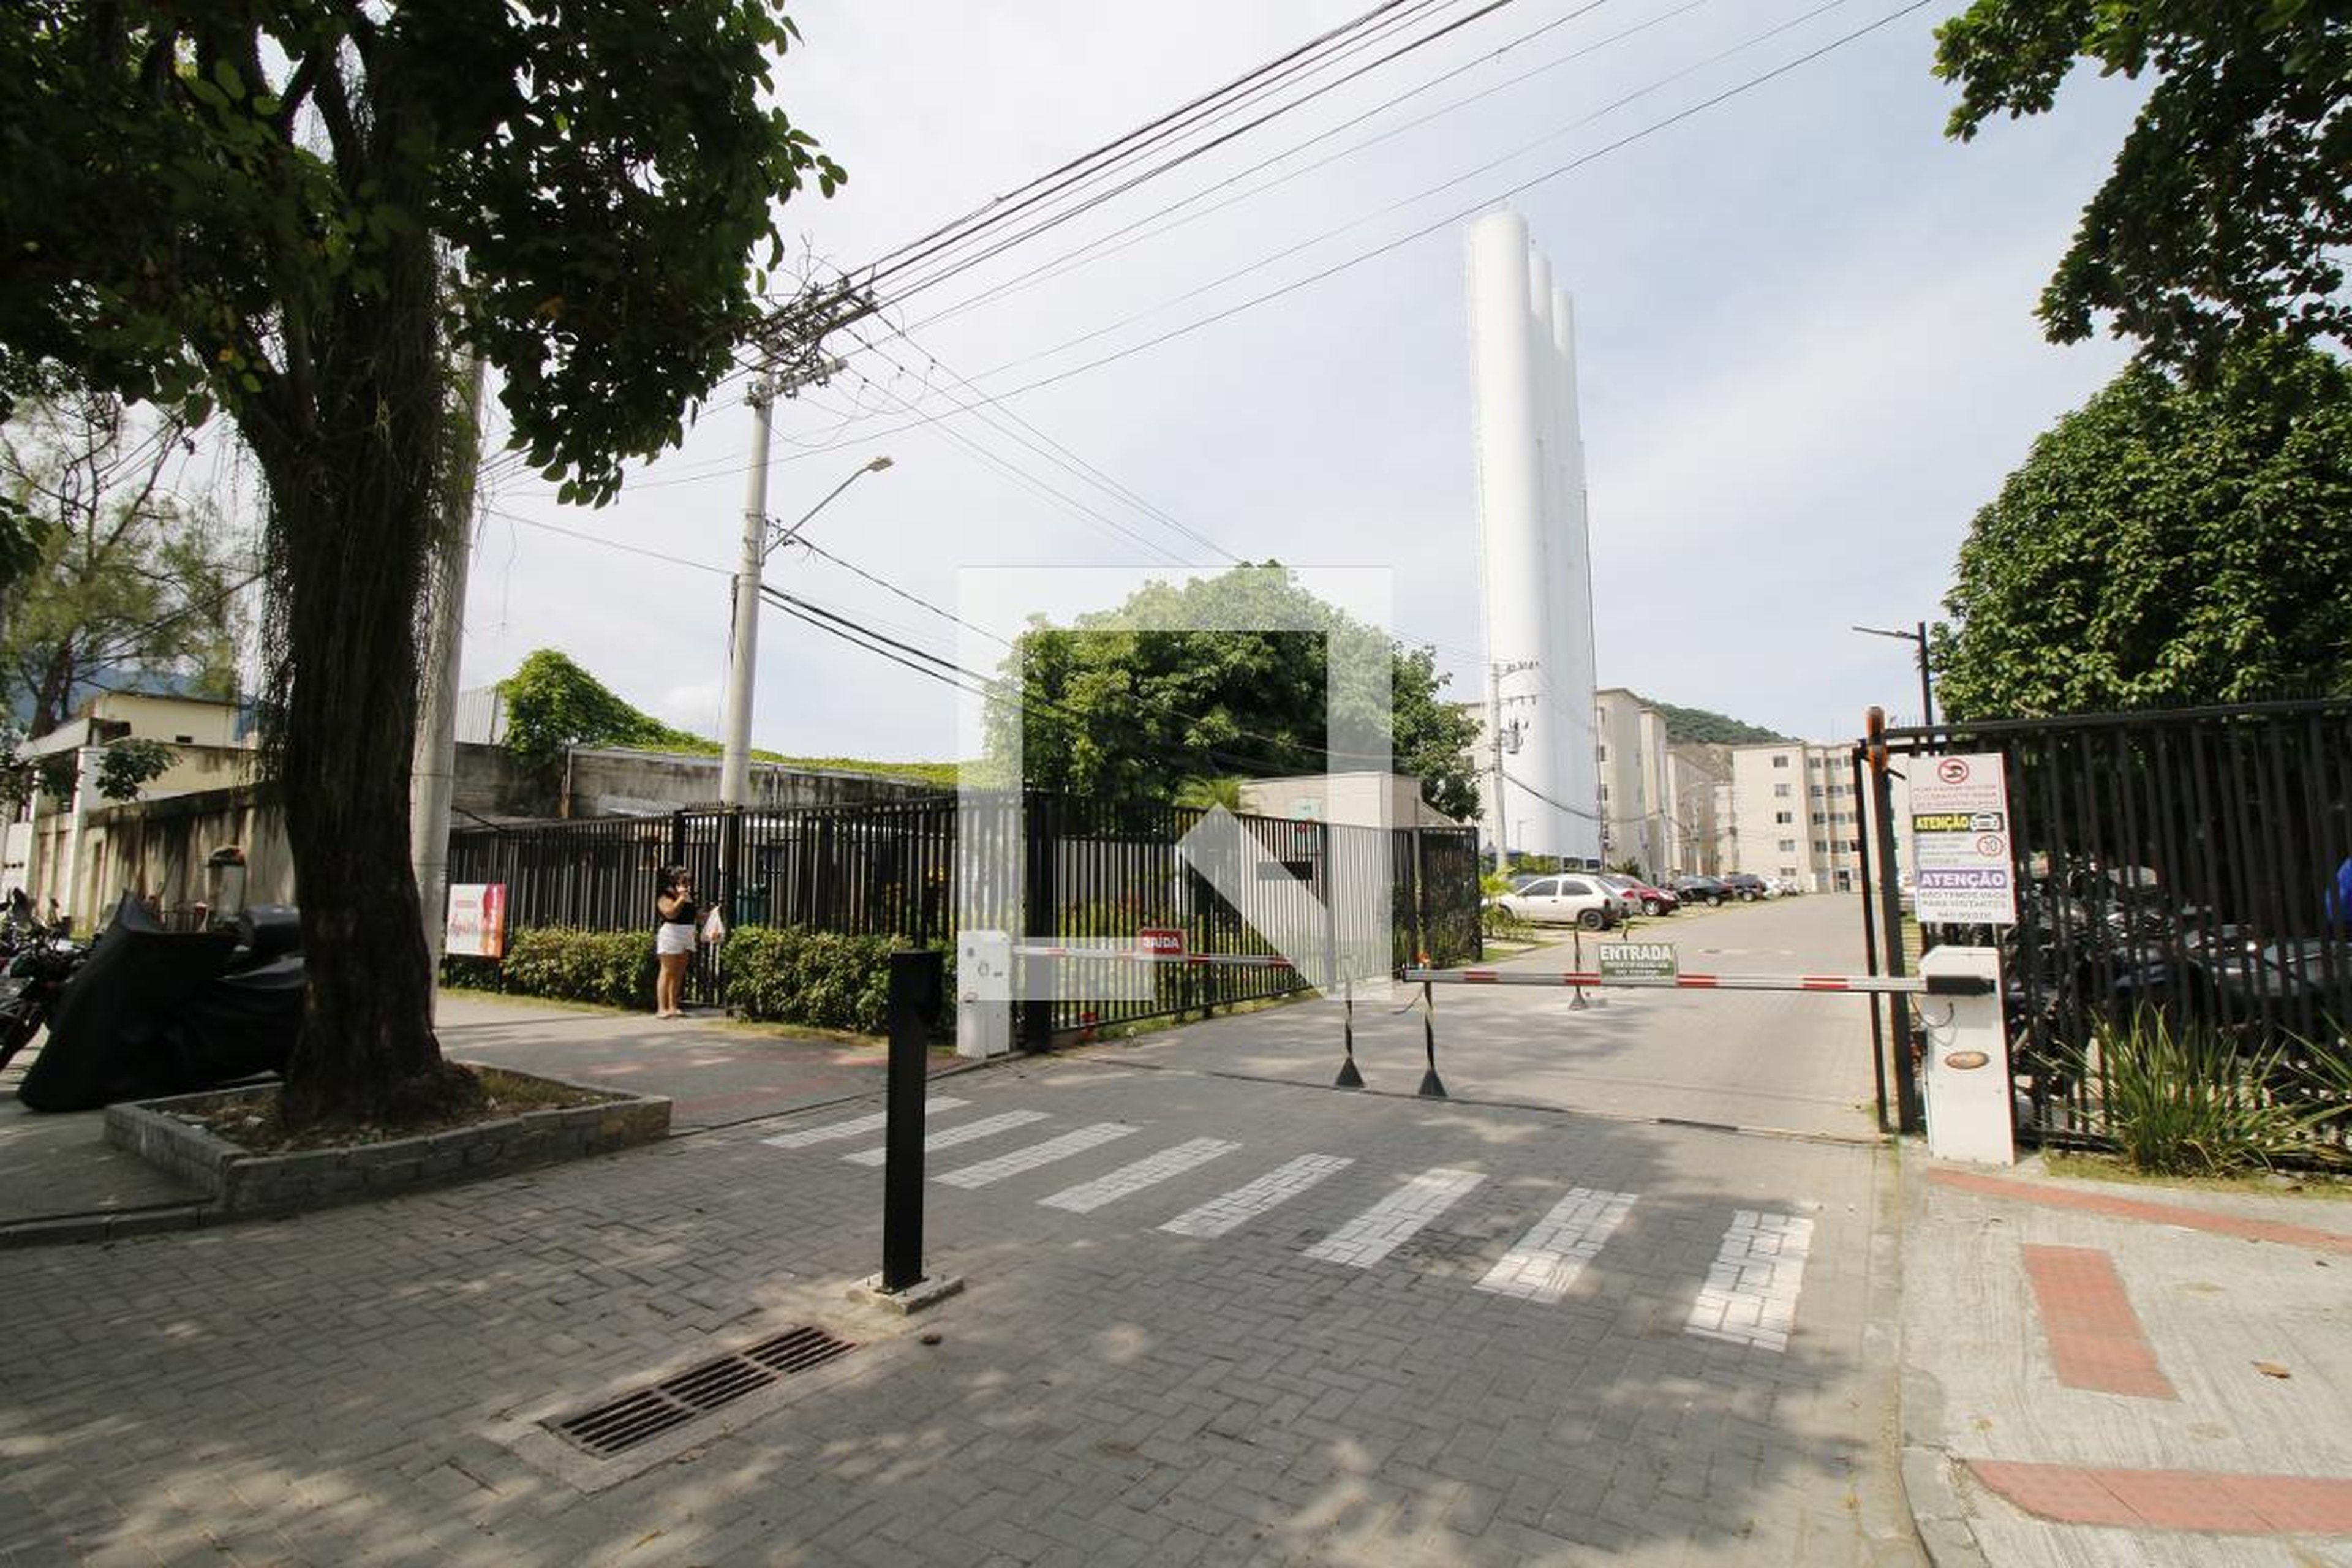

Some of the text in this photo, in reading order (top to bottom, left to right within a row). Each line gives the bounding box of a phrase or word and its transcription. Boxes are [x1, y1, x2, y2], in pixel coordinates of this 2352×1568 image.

[1915, 814, 1969, 831] ATENÇÃO
[1922, 871, 2004, 888] ATENÇÃO
[1143, 933, 1180, 949] SAÍDA
[1600, 945, 1673, 960] ENTRADA
